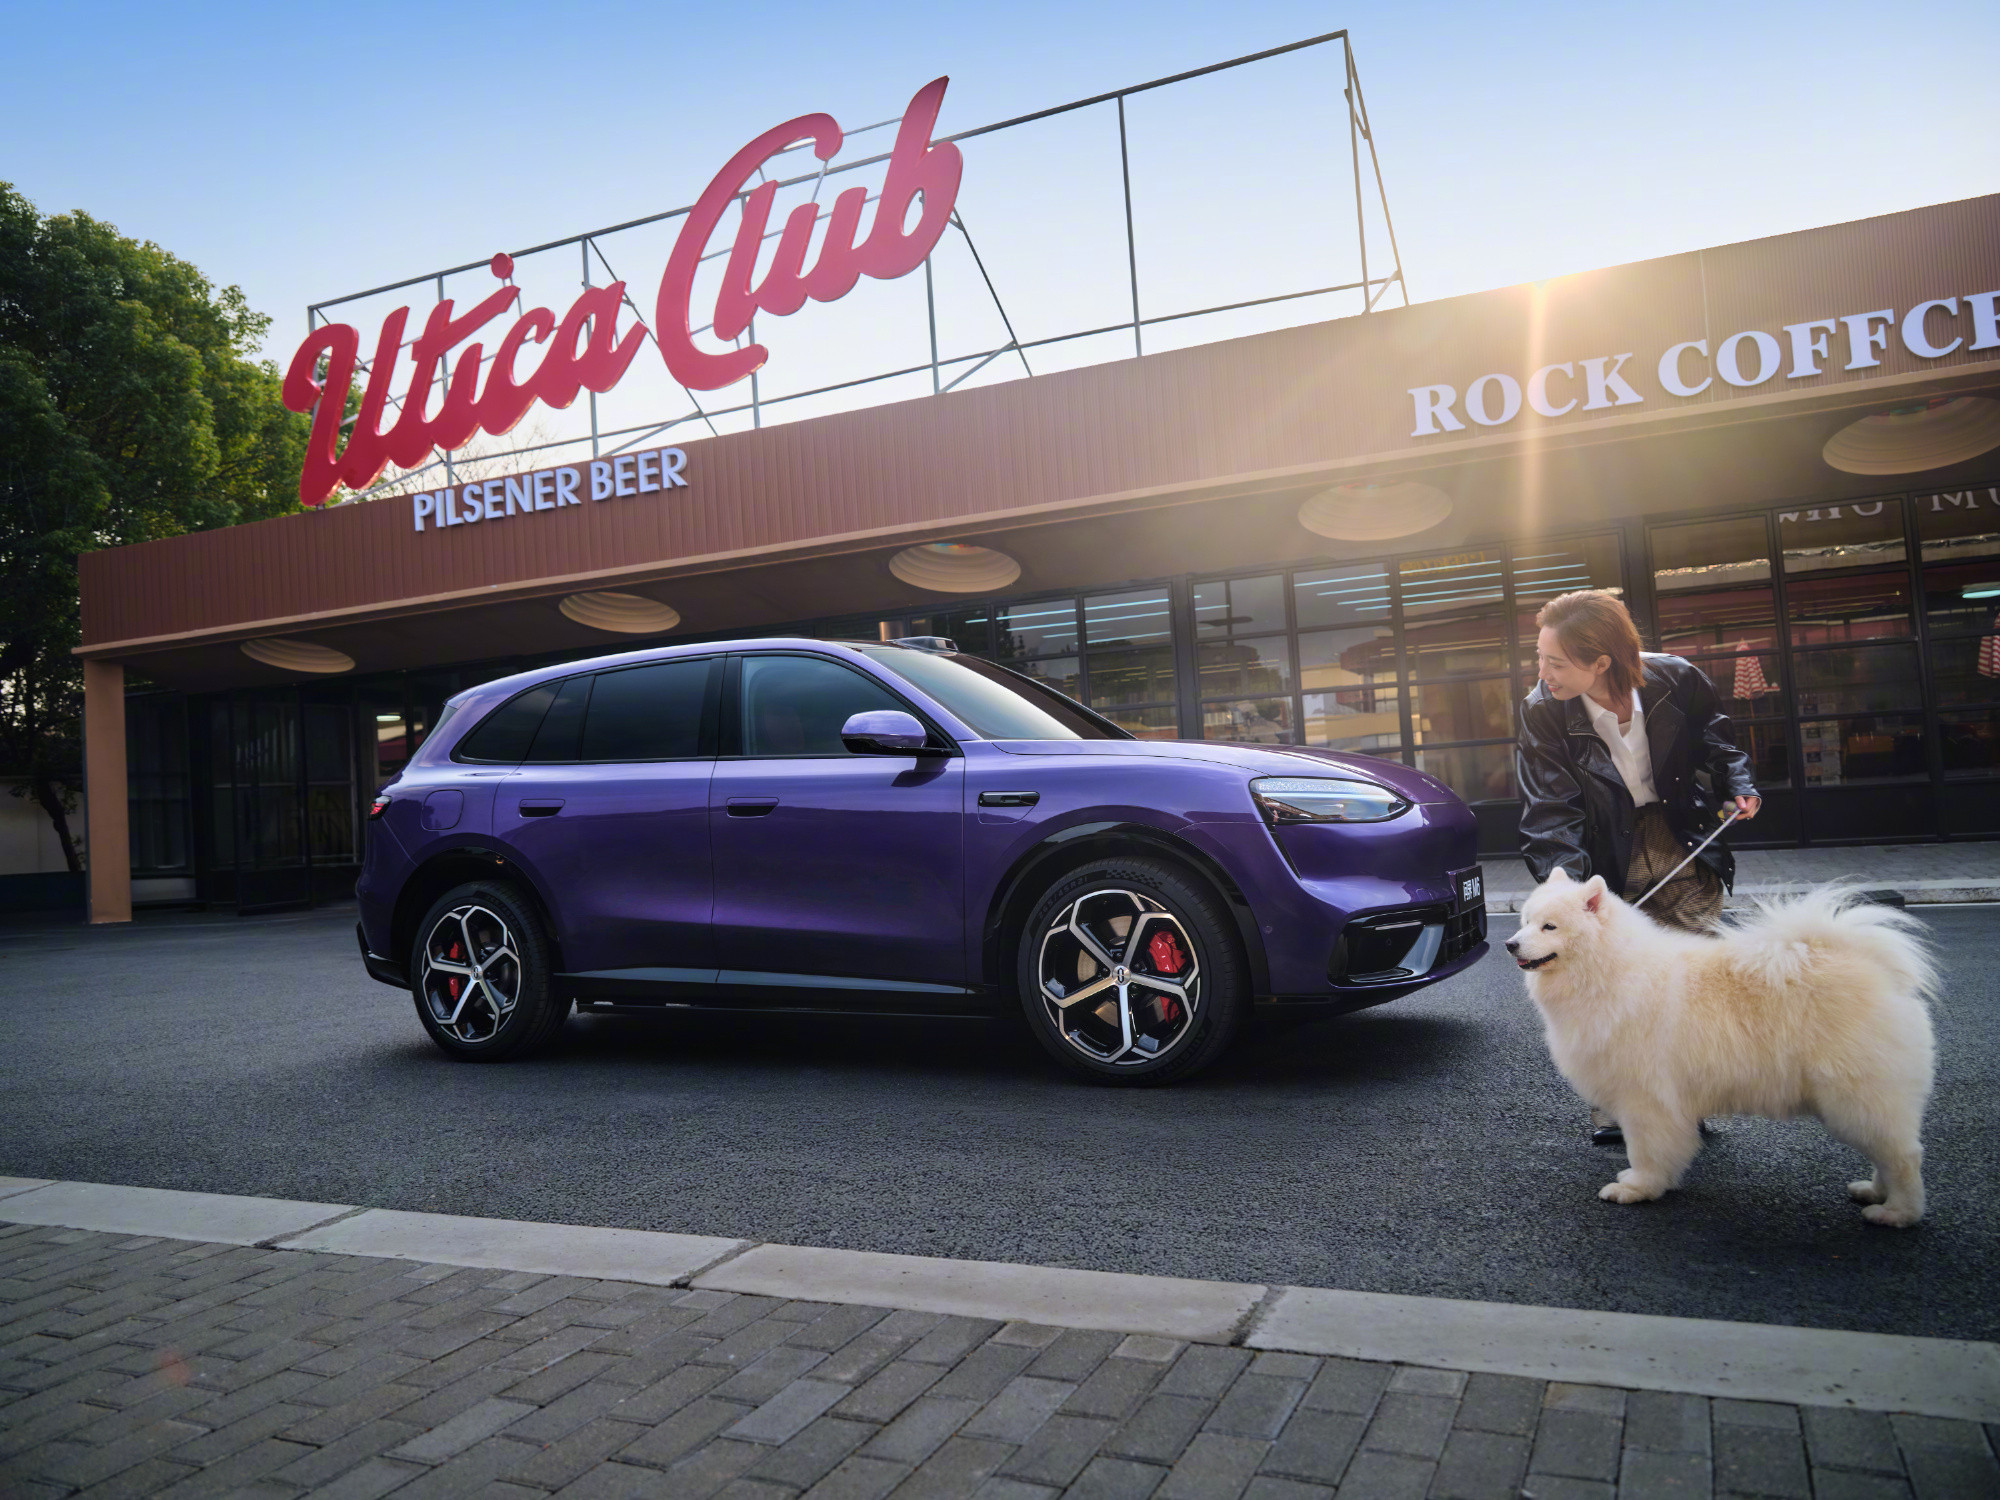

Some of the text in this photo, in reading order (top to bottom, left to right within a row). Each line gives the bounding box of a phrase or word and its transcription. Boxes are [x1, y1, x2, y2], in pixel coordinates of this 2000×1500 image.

[282, 75, 963, 507] Utica Club
[1407, 352, 1644, 437] ROCK
[413, 447, 689, 532] PILSENER BEER
